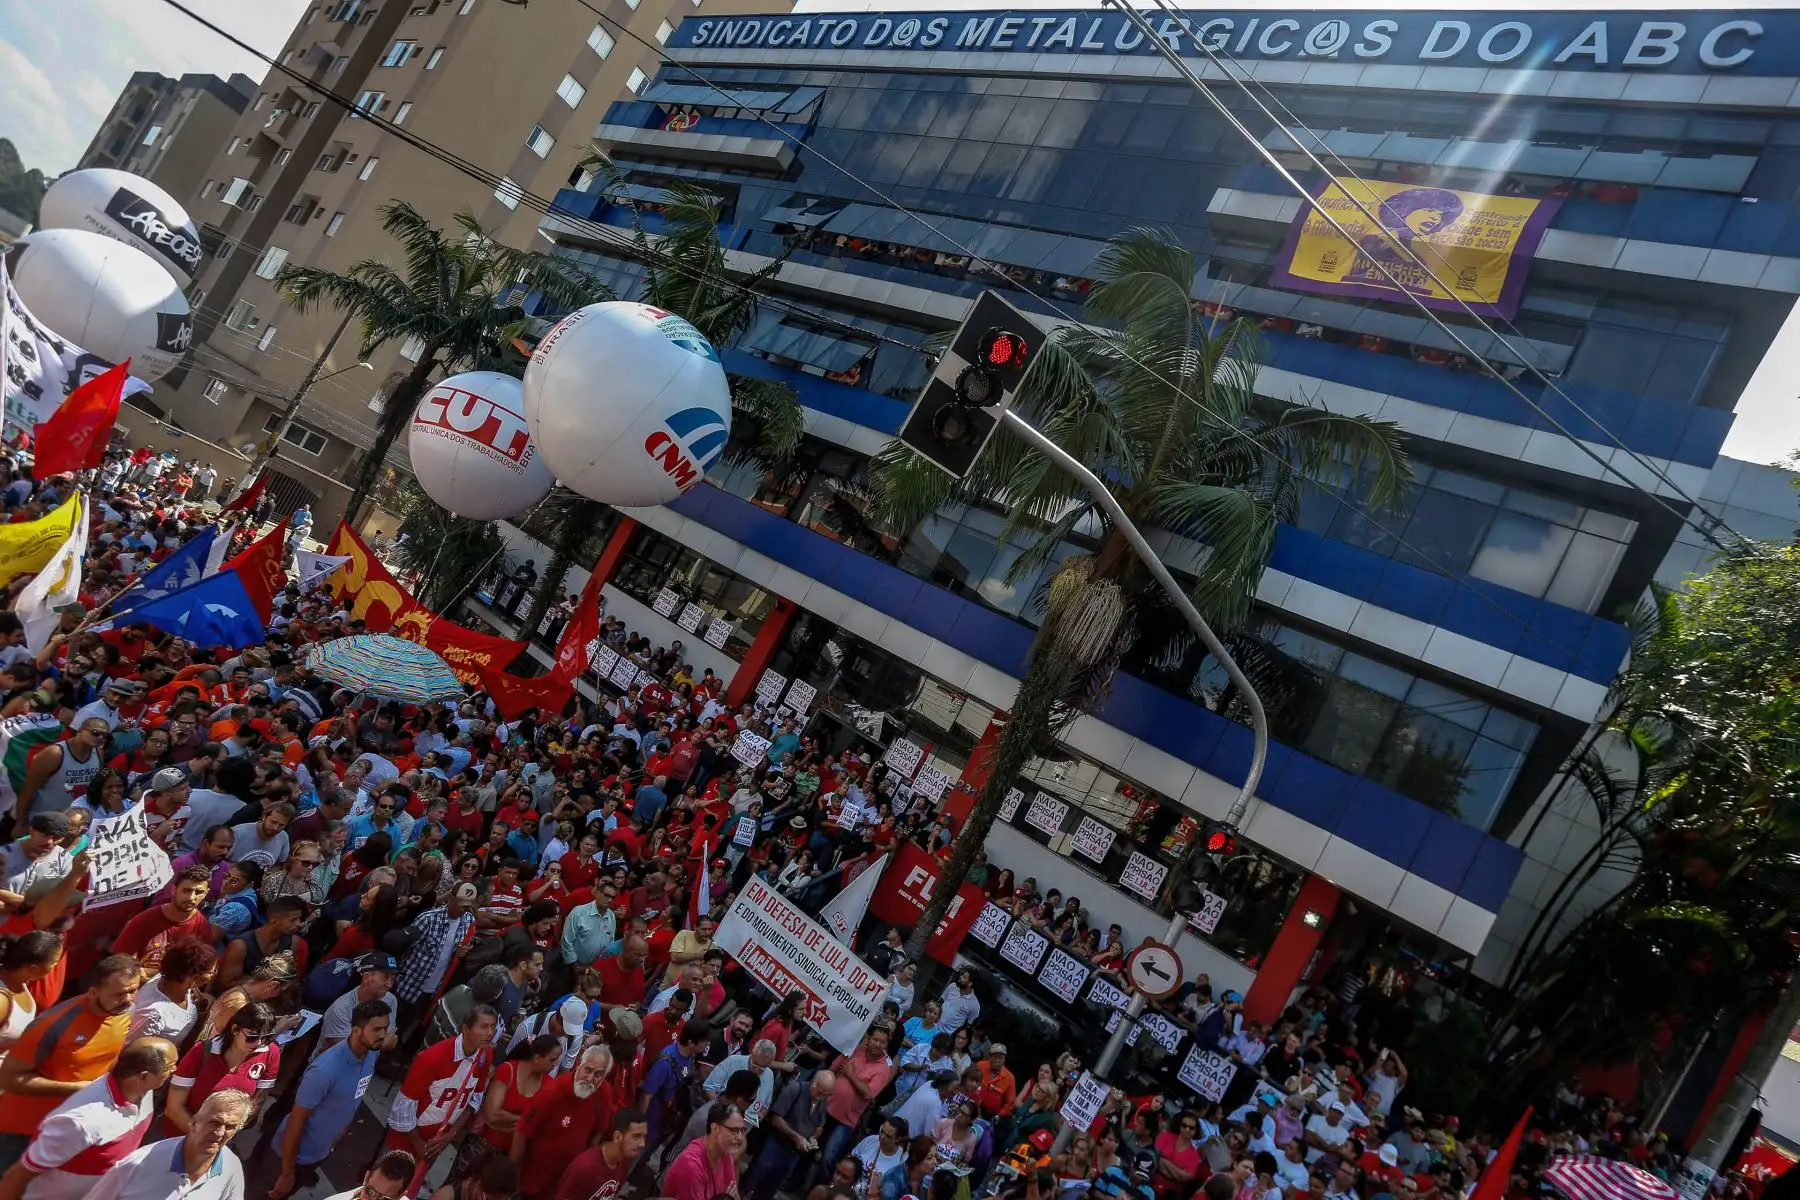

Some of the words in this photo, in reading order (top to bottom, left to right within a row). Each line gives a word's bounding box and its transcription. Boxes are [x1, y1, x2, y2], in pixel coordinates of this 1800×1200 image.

[691, 20, 858, 46] SINDICATO
[863, 18, 949, 47] DOS
[954, 9, 1399, 58] METALÚRGICOS
[1418, 20, 1533, 62] DO
[1552, 19, 1764, 67] ABC
[543, 312, 590, 354] BRASIL
[418, 388, 530, 453] CUT
[450, 433, 465, 445] DOS
[467, 440, 524, 476] TRABALHADORES
[520, 440, 536, 468] BRA
[983, 904, 998, 918] AO
[745, 882, 768, 906] EM
[764, 896, 805, 939] DEFESA
[803, 929, 824, 951] DE
[819, 940, 849, 978] LULA,
[847, 966, 867, 990] DO
[863, 979, 884, 1002] PT
[978, 924, 998, 940] LULA
[734, 903, 743, 915] E
[741, 908, 755, 923] DO
[752, 916, 798, 959] MOVIMENTO
[795, 952, 829, 990] SINDICAL
[827, 979, 835, 993] E
[832, 985, 869, 1022] POPULAR
[815, 1010, 827, 1023] PT
[1075, 1095, 1089, 1110] LULA
[1084, 1079, 1098, 1094] LULA
